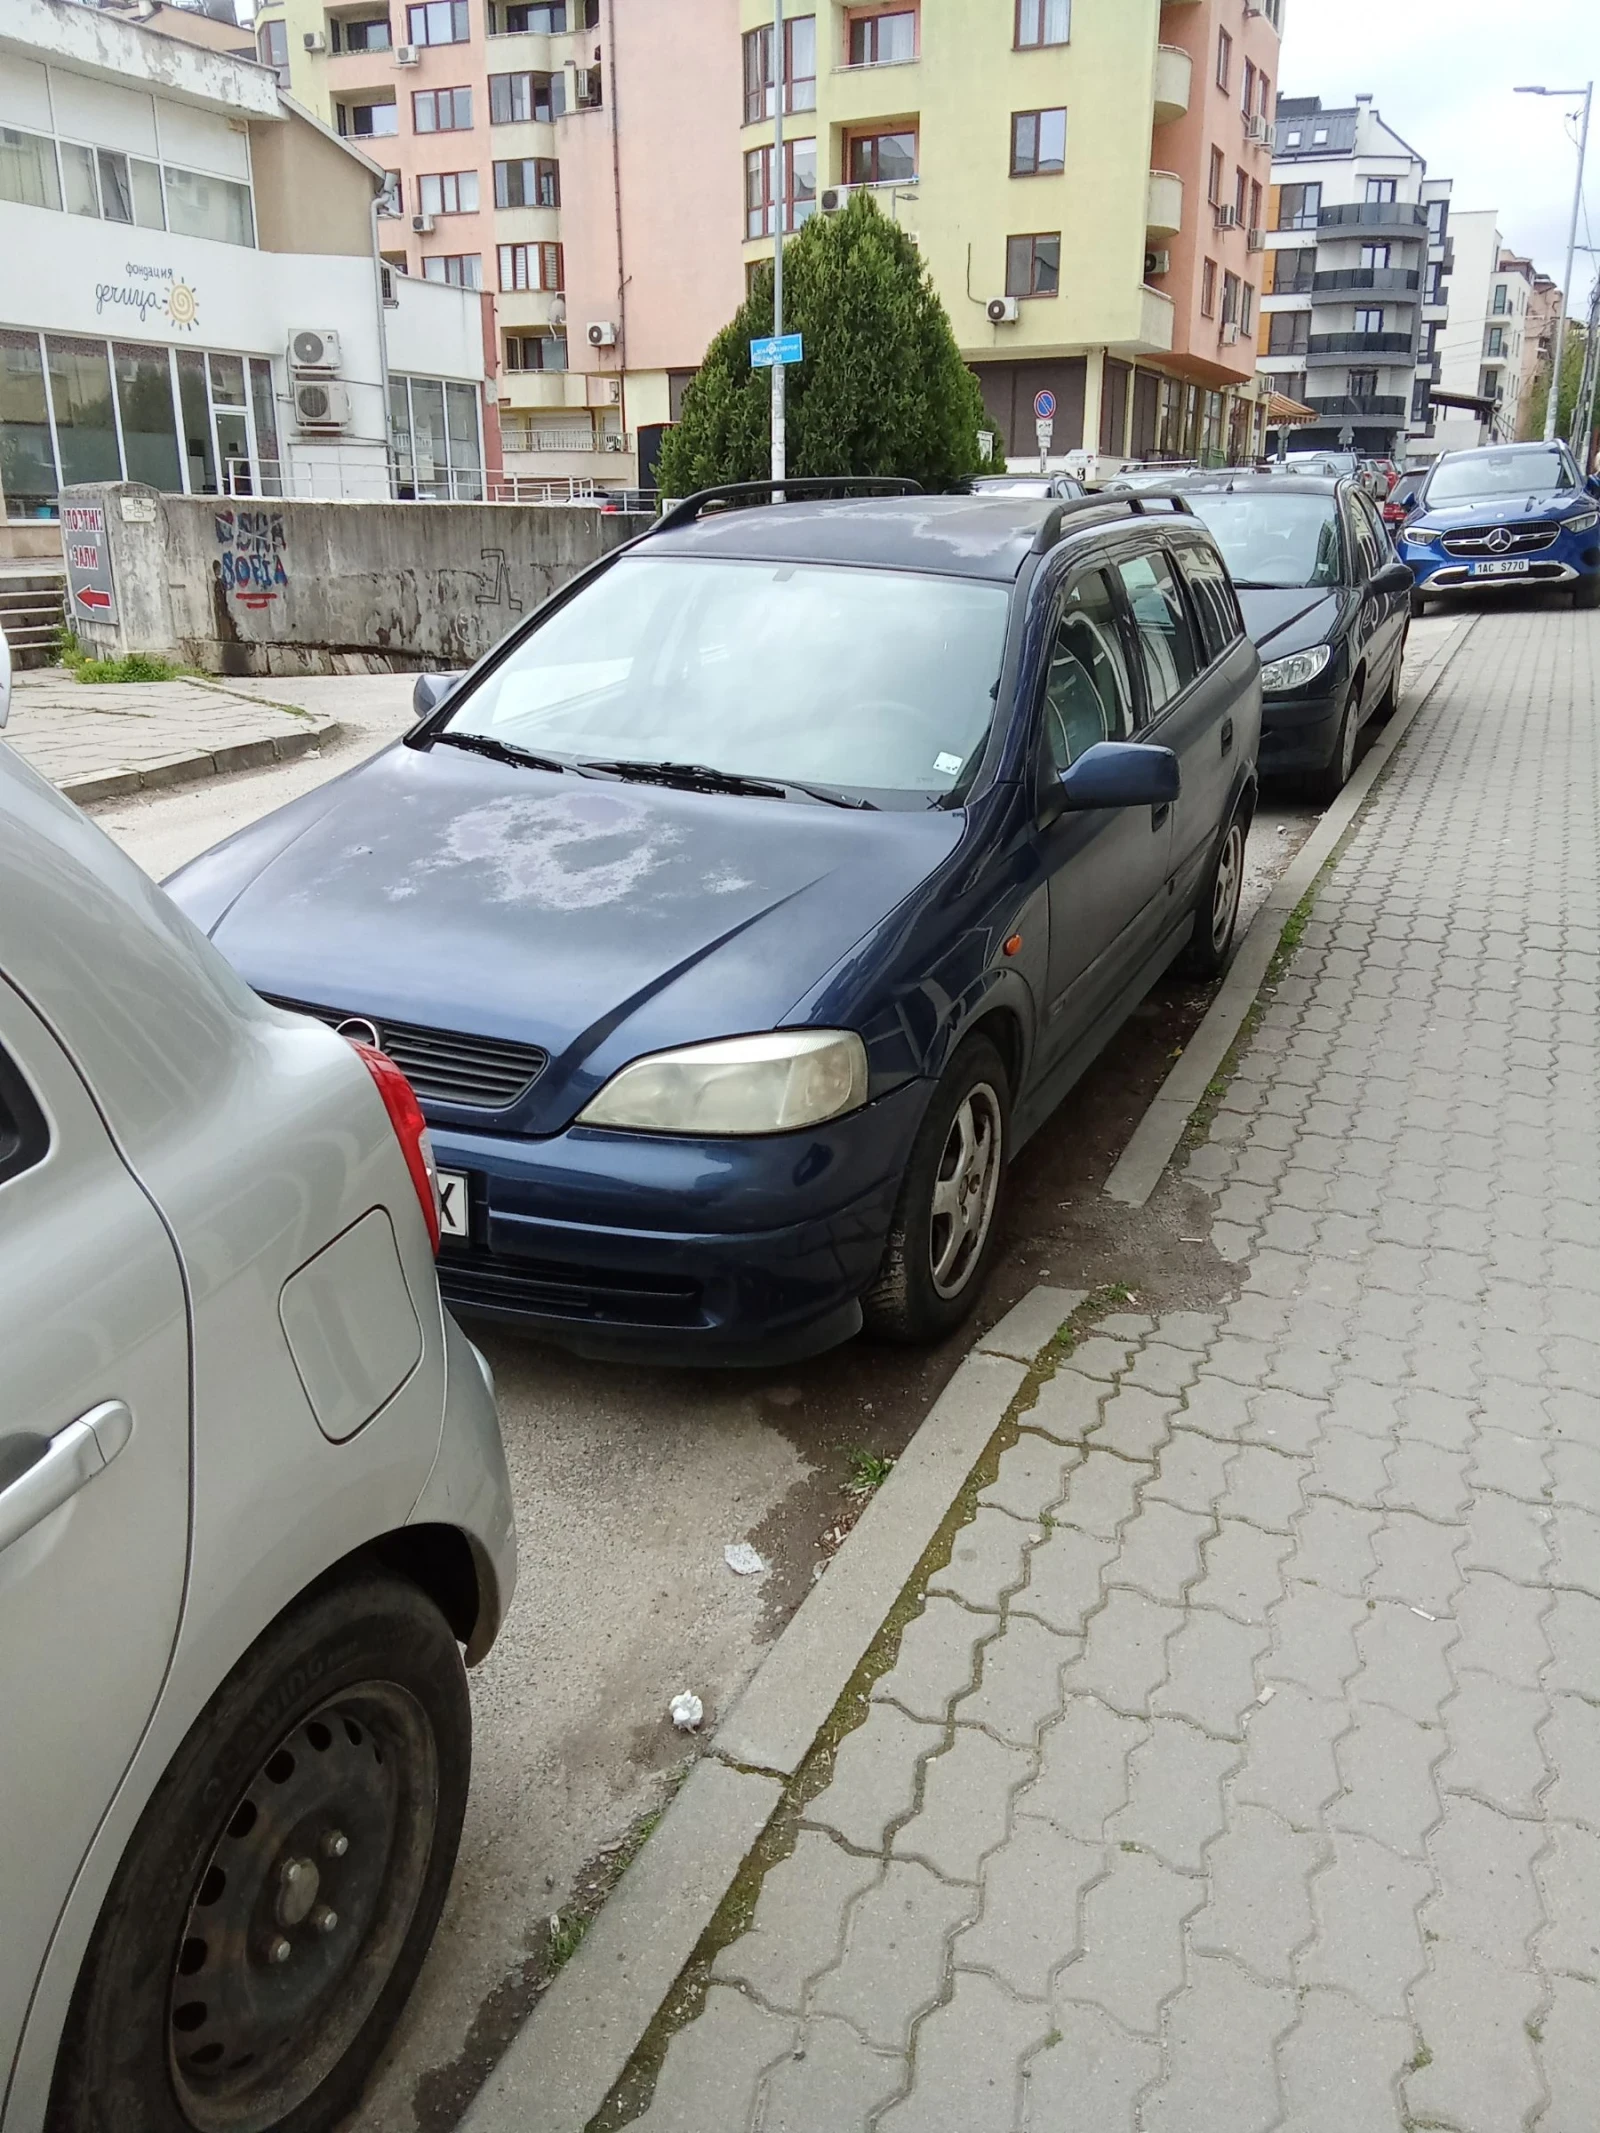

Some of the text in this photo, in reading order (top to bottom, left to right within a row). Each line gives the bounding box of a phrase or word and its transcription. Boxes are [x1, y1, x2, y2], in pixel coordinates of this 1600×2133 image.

[125, 261, 173, 281] фондация
[63, 508, 105, 532] ПОРТНИ
[73, 545, 99, 570] ЗАЛИ
[1478, 561, 1525, 573] 1AC S770
